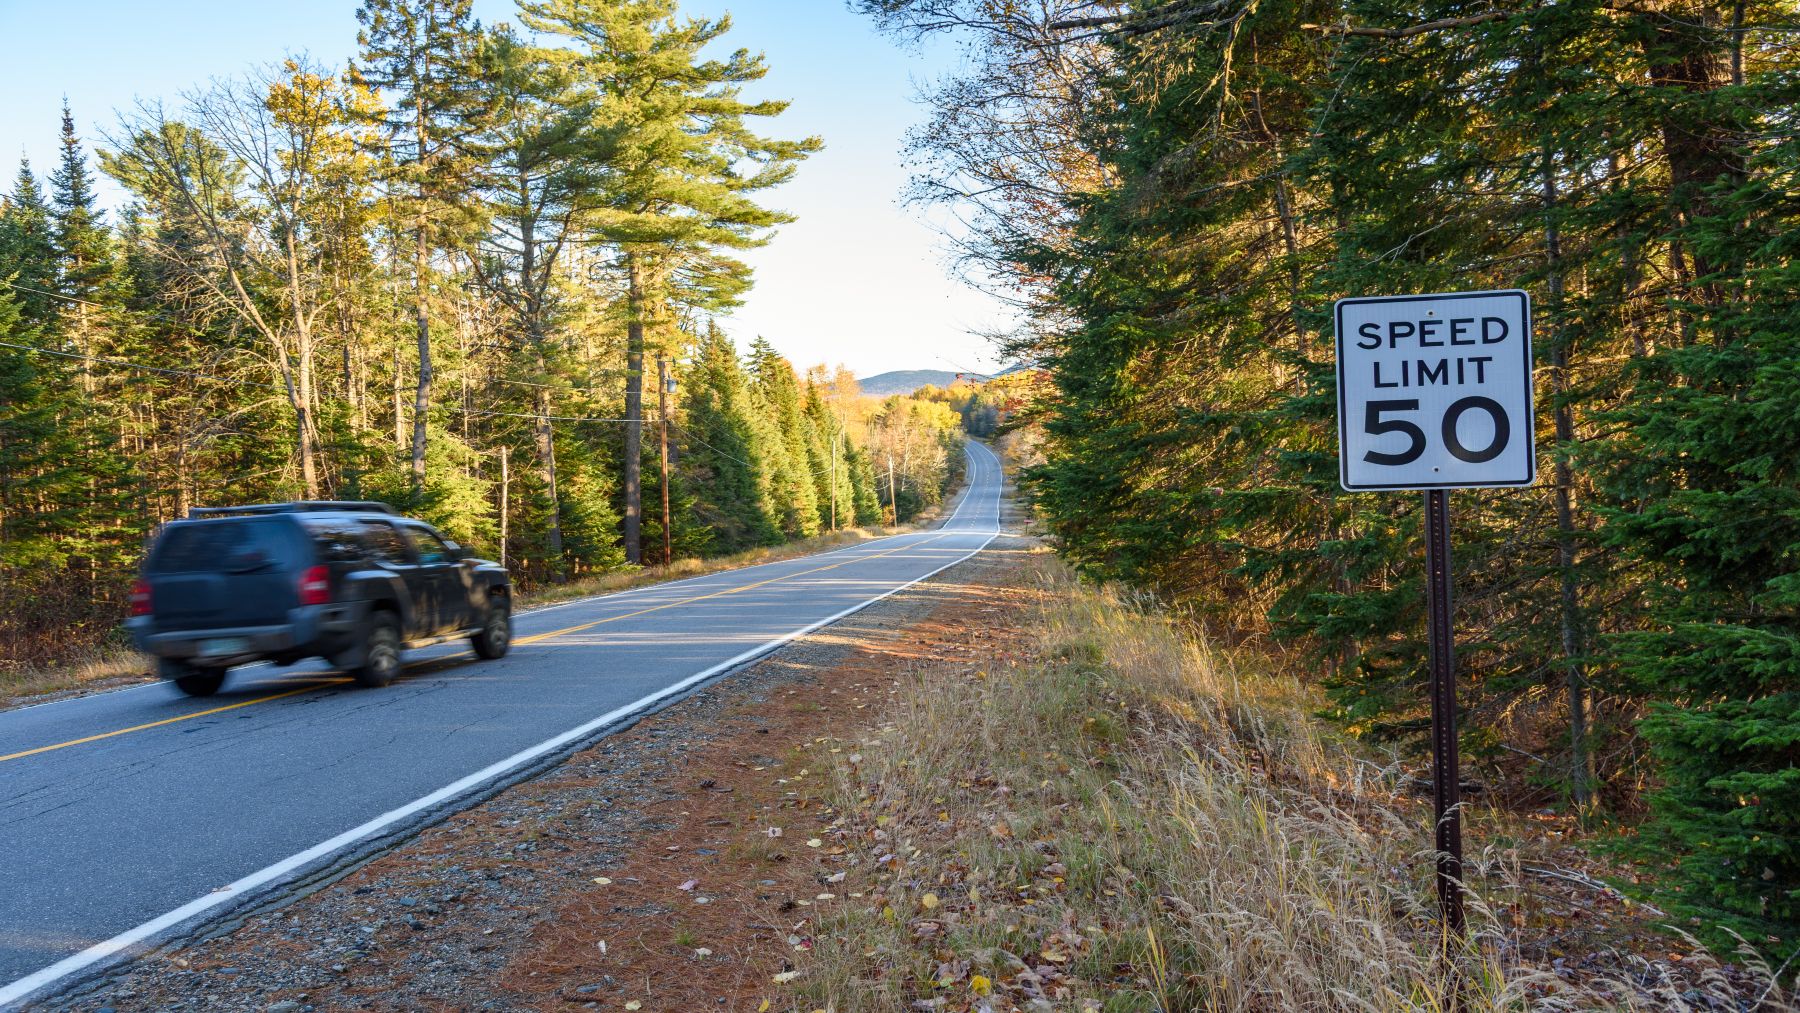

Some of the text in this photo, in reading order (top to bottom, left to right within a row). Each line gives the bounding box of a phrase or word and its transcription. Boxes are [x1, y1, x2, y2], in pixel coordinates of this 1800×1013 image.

[1357, 317, 1509, 350] SPEED
[1374, 356, 1493, 388] LIMIT
[1363, 396, 1510, 466] 50
